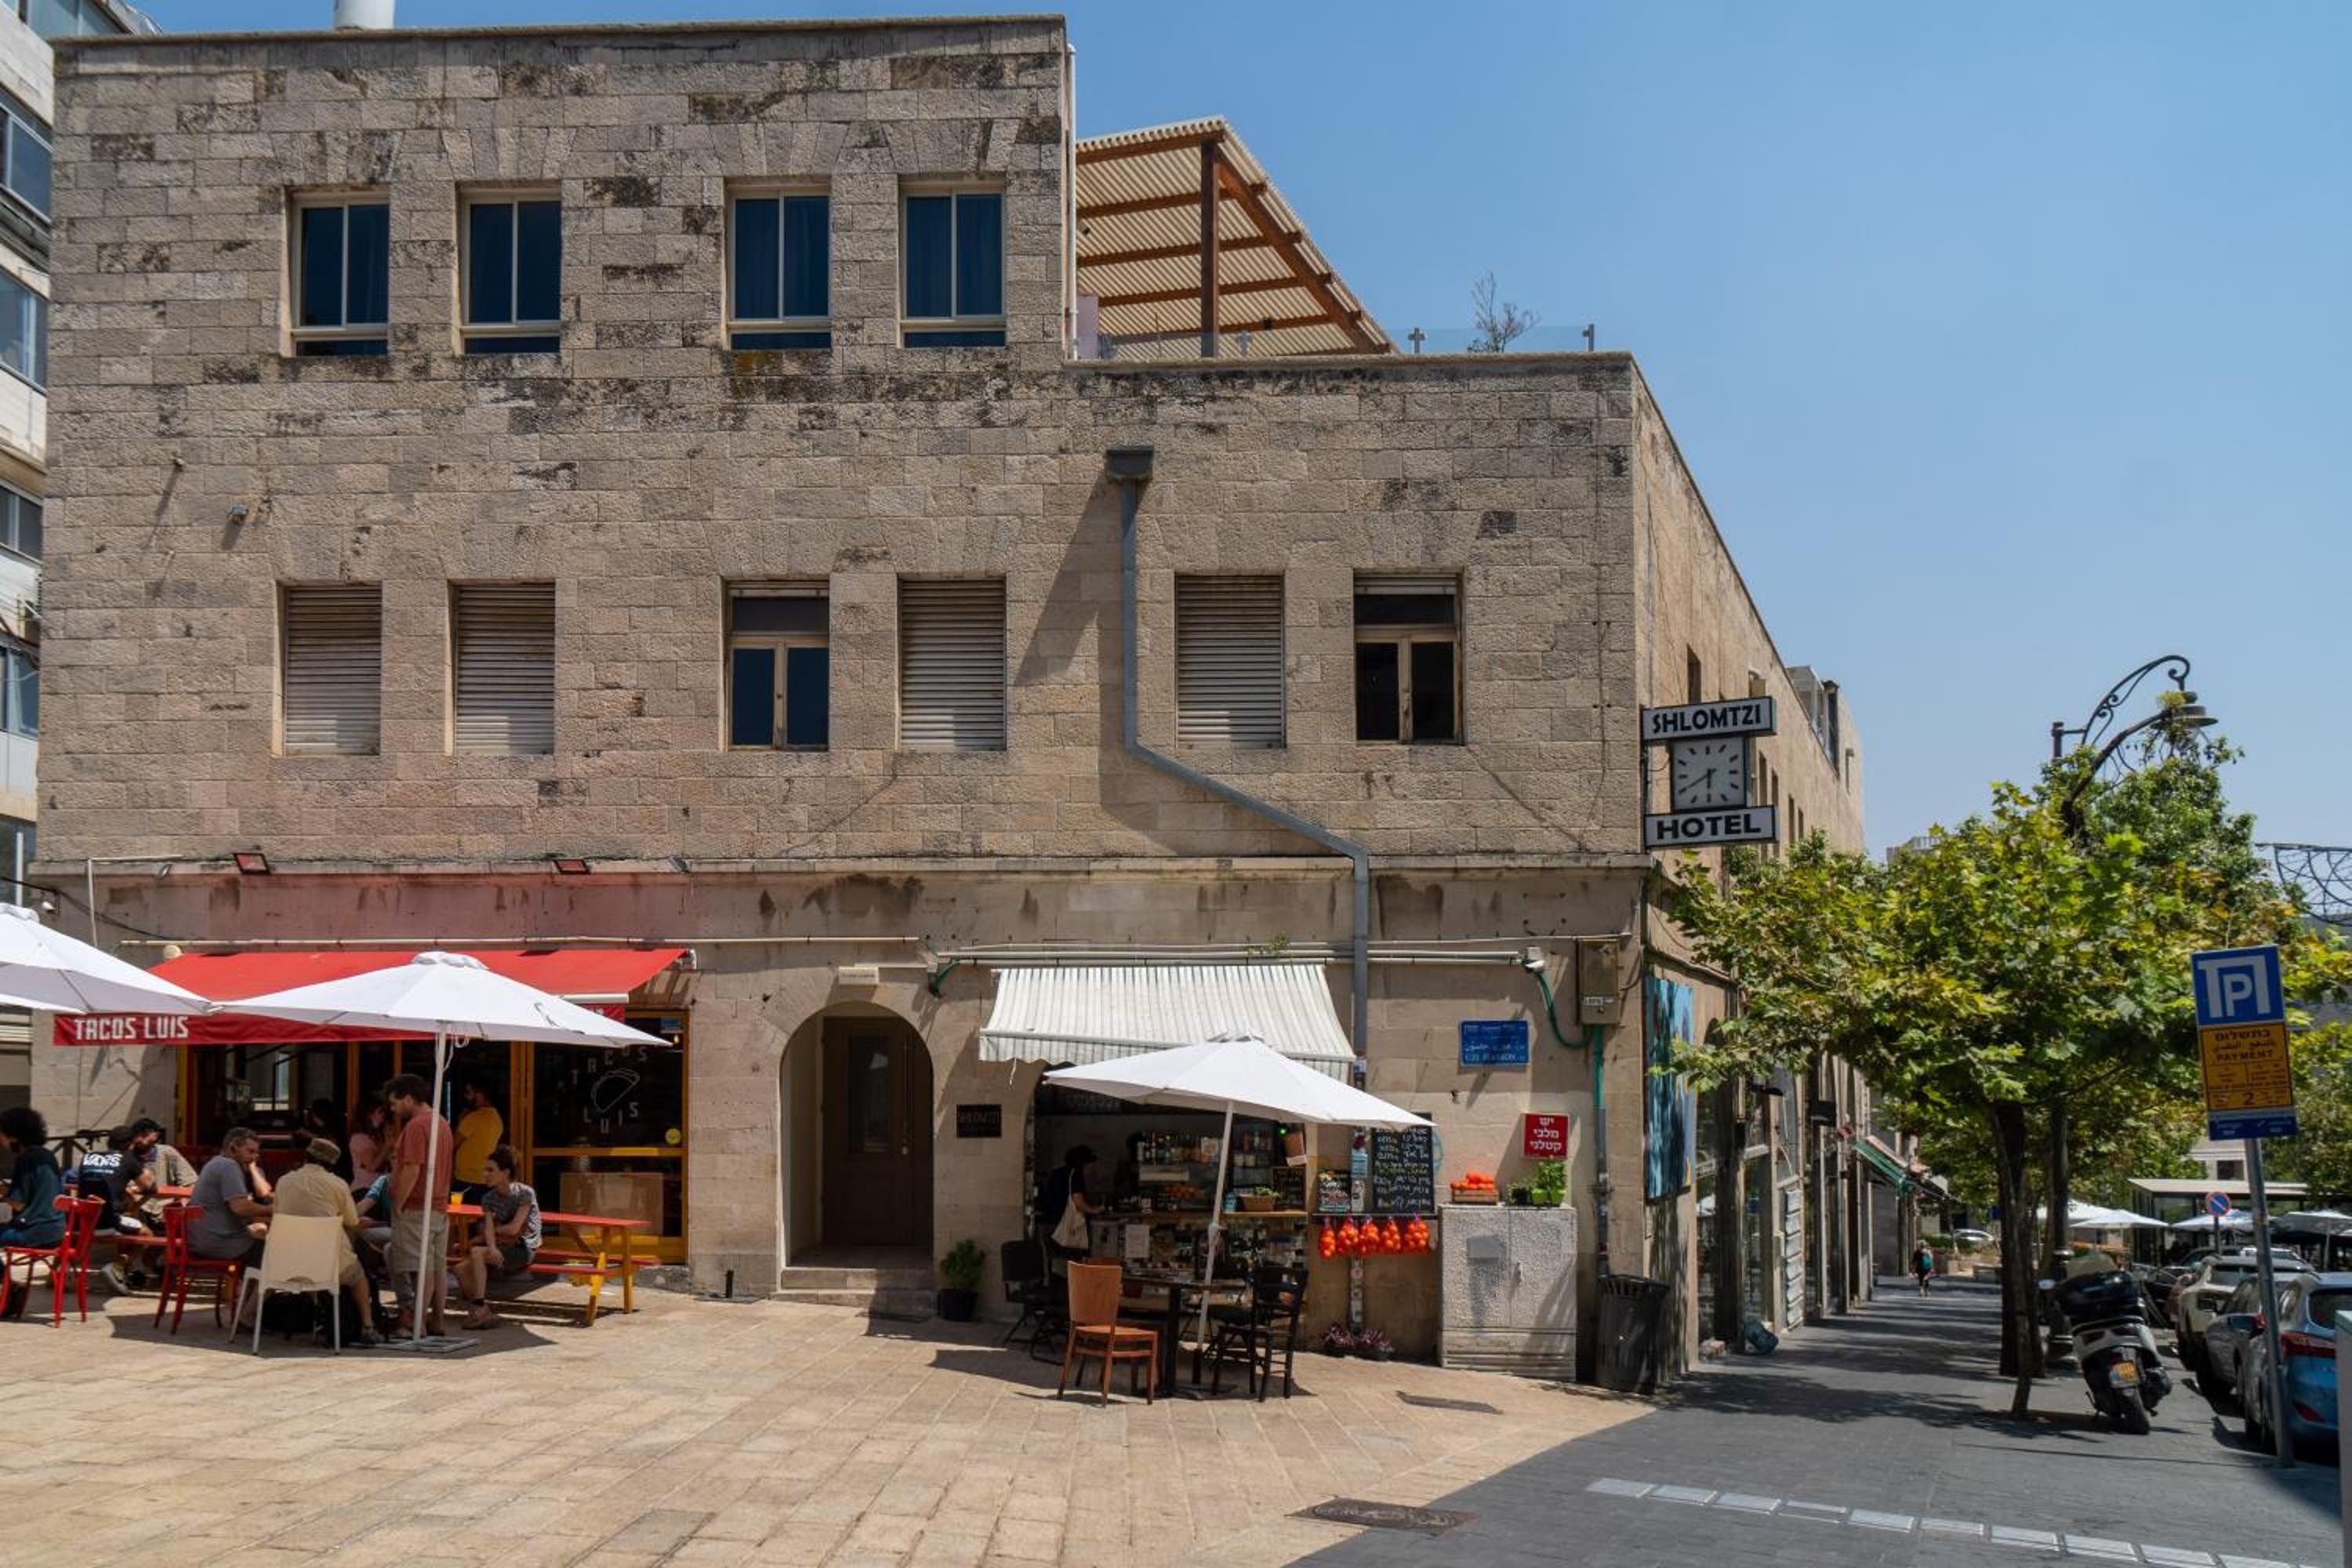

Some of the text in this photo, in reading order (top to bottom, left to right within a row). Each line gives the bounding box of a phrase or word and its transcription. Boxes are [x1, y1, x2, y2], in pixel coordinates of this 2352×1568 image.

[1653, 703, 1762, 734] SHLOMTZI
[1656, 813, 1762, 840] HOTEL
[74, 1015, 189, 1040] TACOS LUIS
[2216, 1049, 2274, 1061] PAYMENT
[2243, 1092, 2256, 1105] 2
[583, 1102, 640, 1134] LUIS
[1539, 1116, 1555, 1127] יש
